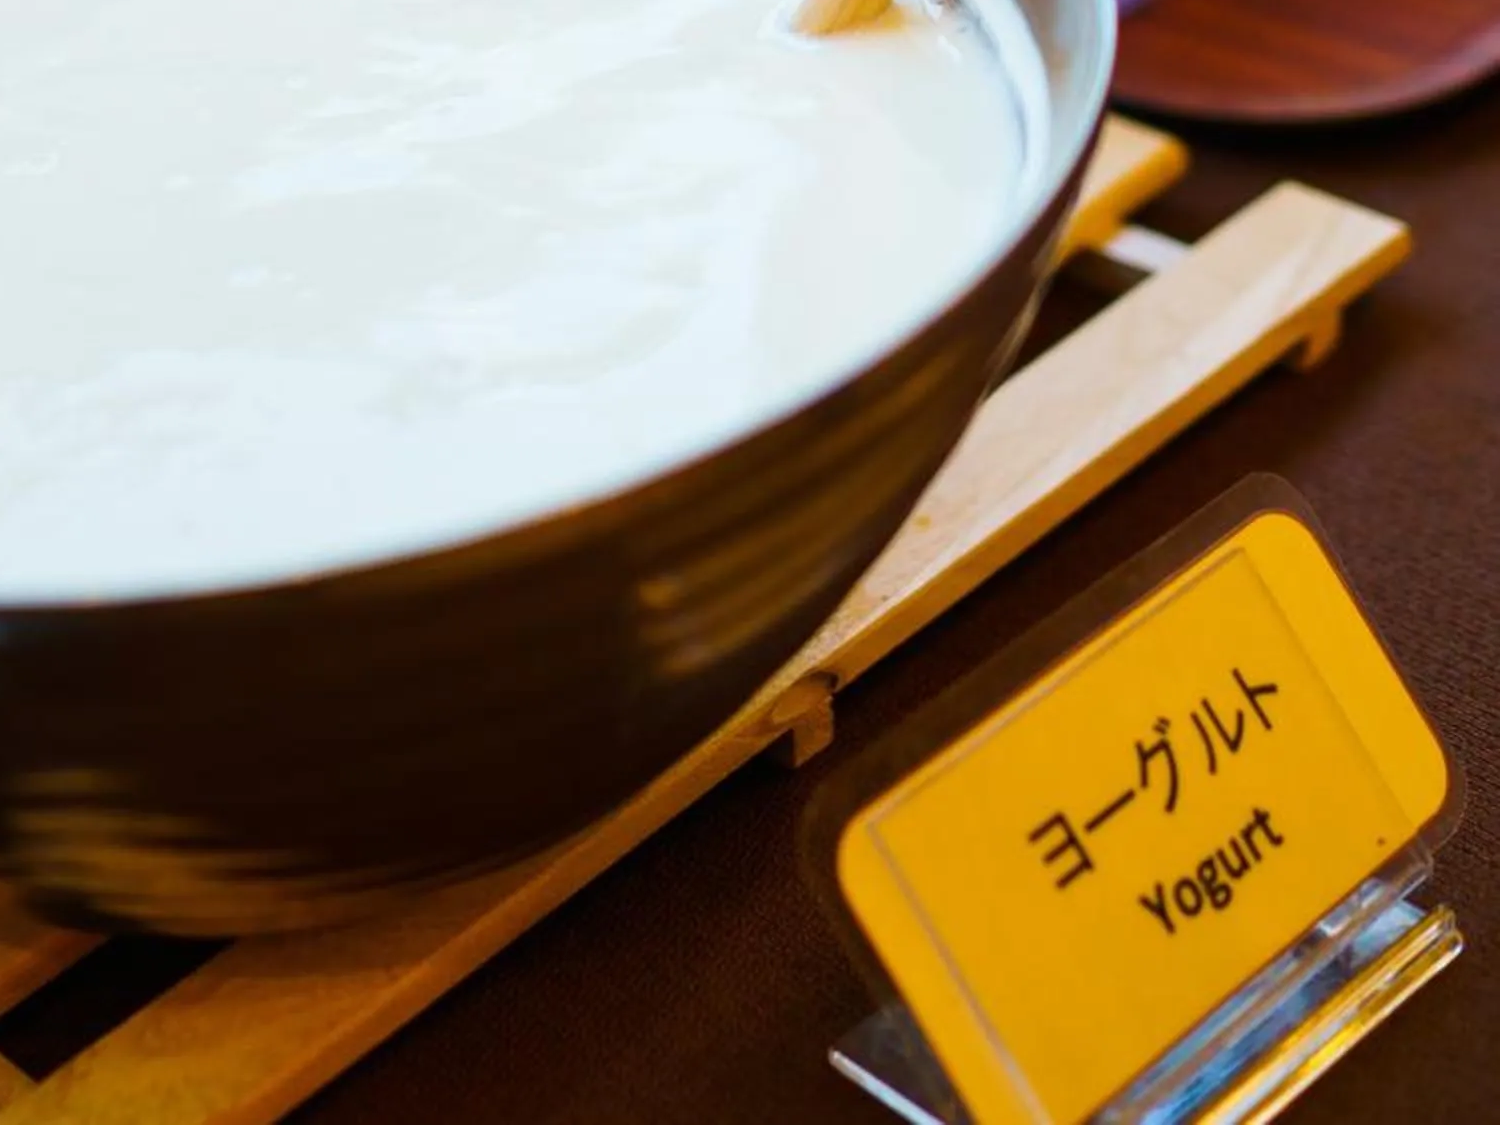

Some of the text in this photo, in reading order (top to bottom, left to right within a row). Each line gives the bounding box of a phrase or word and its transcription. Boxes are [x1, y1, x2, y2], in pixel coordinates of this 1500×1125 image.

[1027, 668, 1278, 891] ヨーグルト
[1138, 807, 1286, 936] Yogurt
